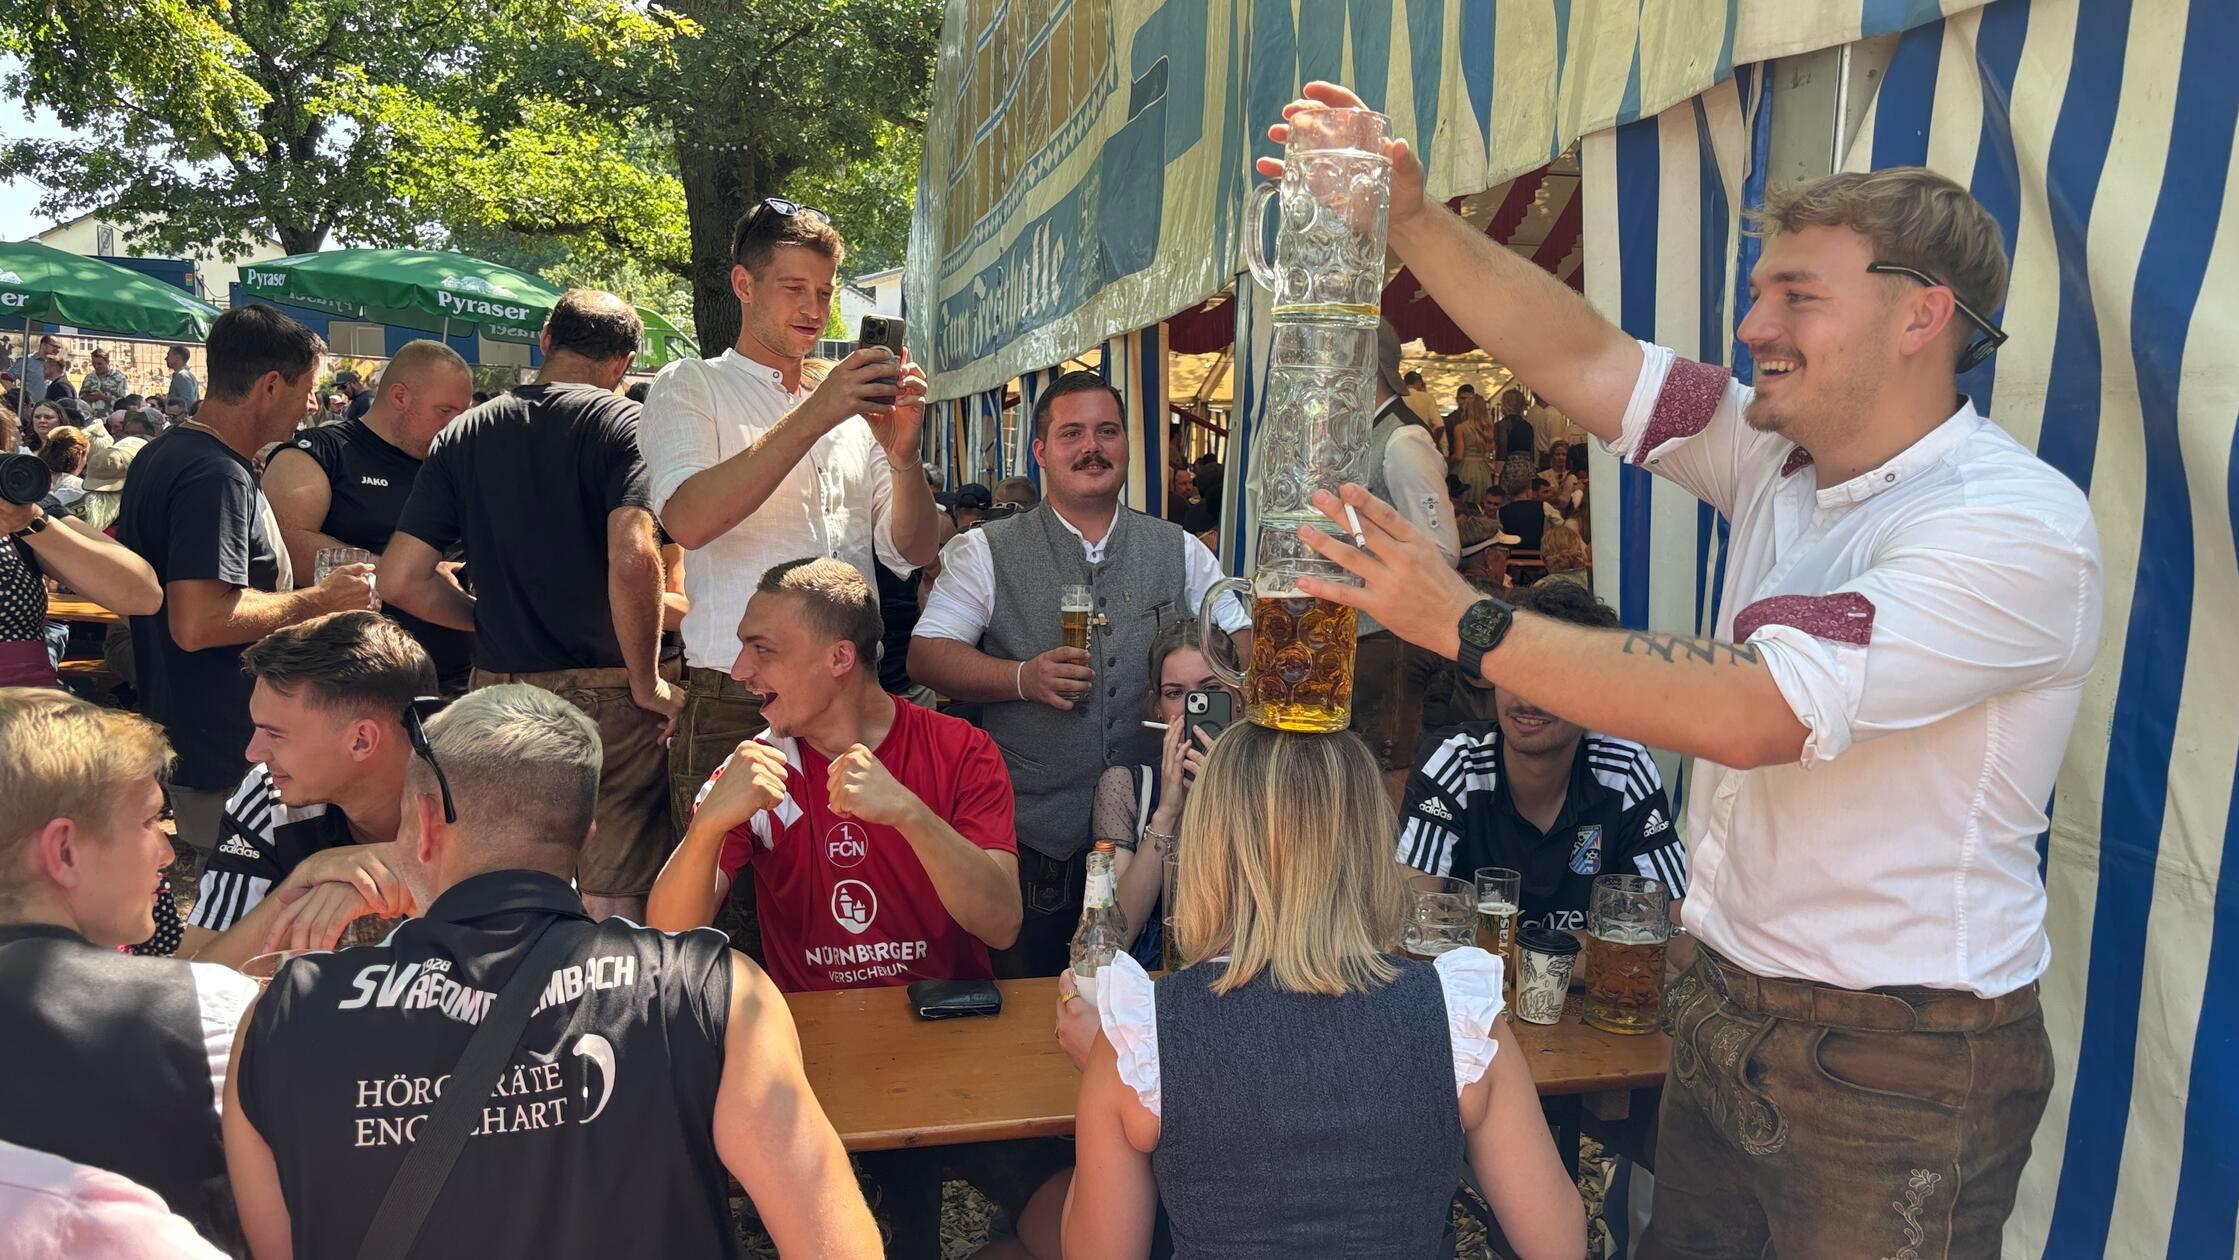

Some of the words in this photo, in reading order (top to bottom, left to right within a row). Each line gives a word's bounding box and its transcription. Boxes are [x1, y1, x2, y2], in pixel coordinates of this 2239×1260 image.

[1, 291, 30, 307] er
[437, 291, 529, 320] Pyraser
[361, 476, 389, 487] JAKO
[1419, 803, 1453, 820] adidas
[1643, 820, 1670, 837] adidas
[219, 844, 260, 859] adidas
[829, 841, 865, 858] FCN
[805, 940, 928, 966] NÜRNBERGER
[419, 958, 452, 976] 1928
[828, 963, 909, 983] VERSICHERUN
[338, 960, 422, 1010] SV
